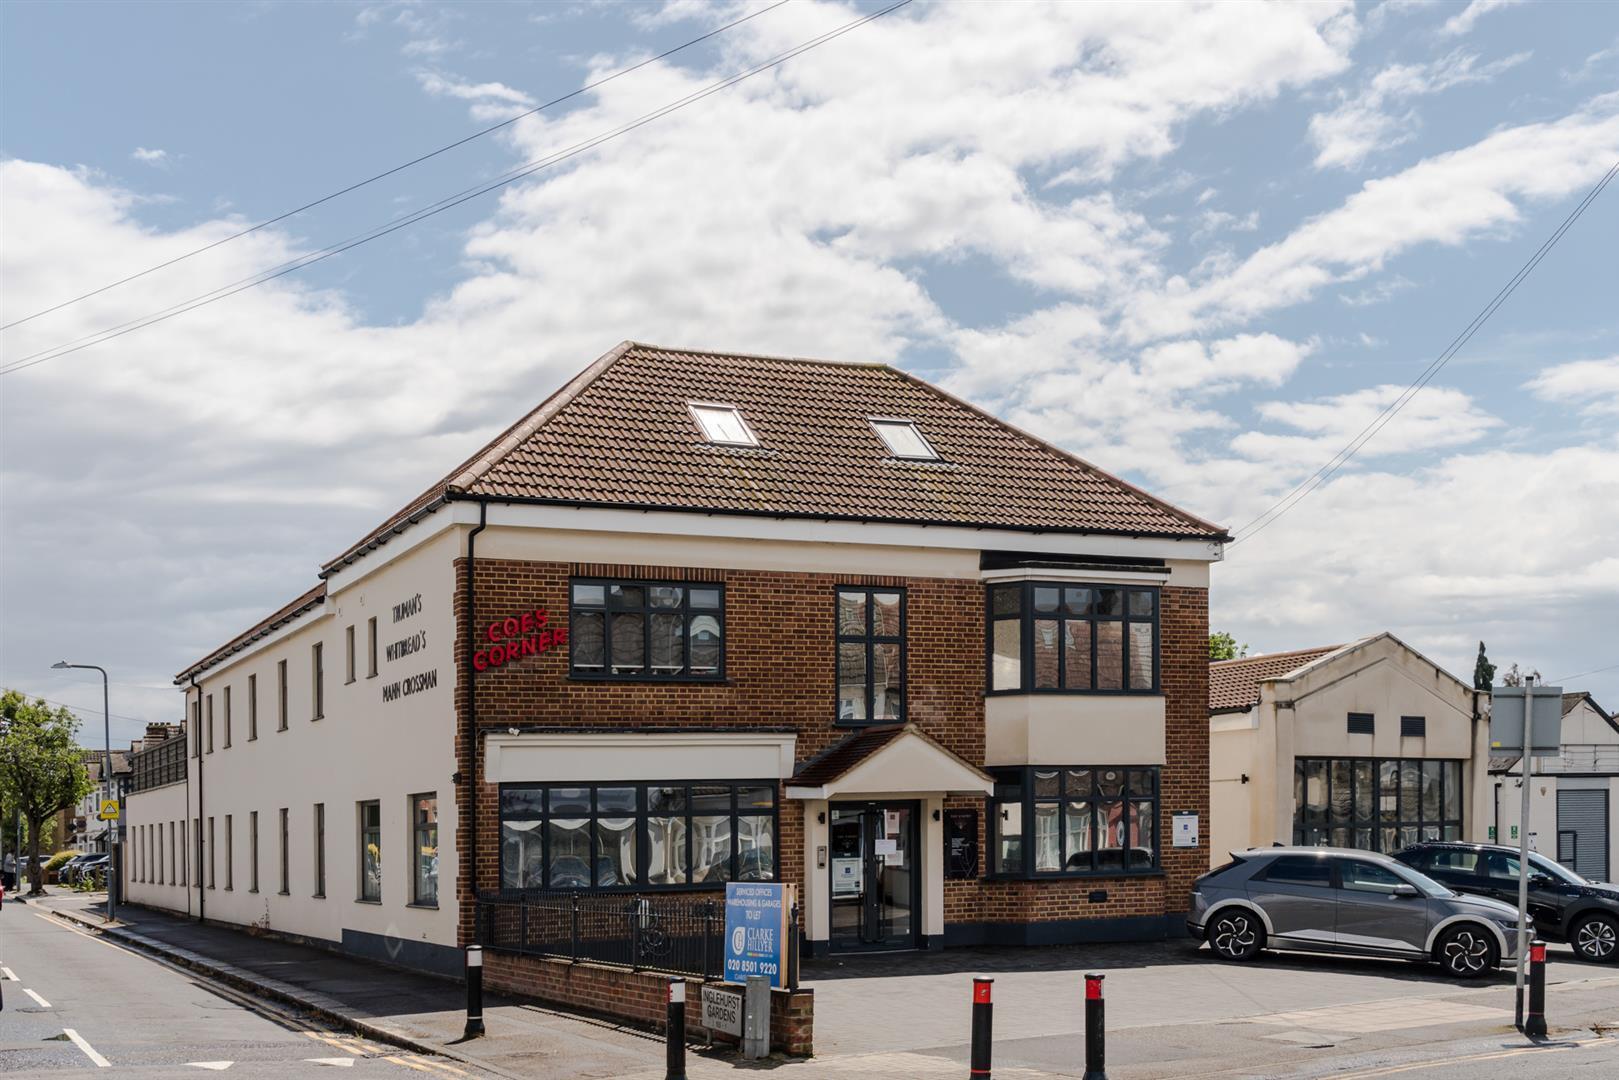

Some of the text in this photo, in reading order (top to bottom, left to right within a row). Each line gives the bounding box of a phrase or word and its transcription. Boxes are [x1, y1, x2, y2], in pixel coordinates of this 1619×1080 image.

[392, 593, 422, 624] TRUMAN'S
[488, 608, 548, 642] COES
[386, 630, 426, 663] WHITBREAD'S
[473, 628, 568, 670] CORNER
[382, 668, 438, 702] MANN CROSSMAN
[745, 910, 761, 920] TO LET
[747, 927, 774, 941] CLARKE
[747, 940, 773, 952] HILLYER
[728, 958, 777, 975] 020 8501 9220
[703, 990, 740, 1010] INGLEHURST
[707, 1004, 736, 1024] GARDENS
